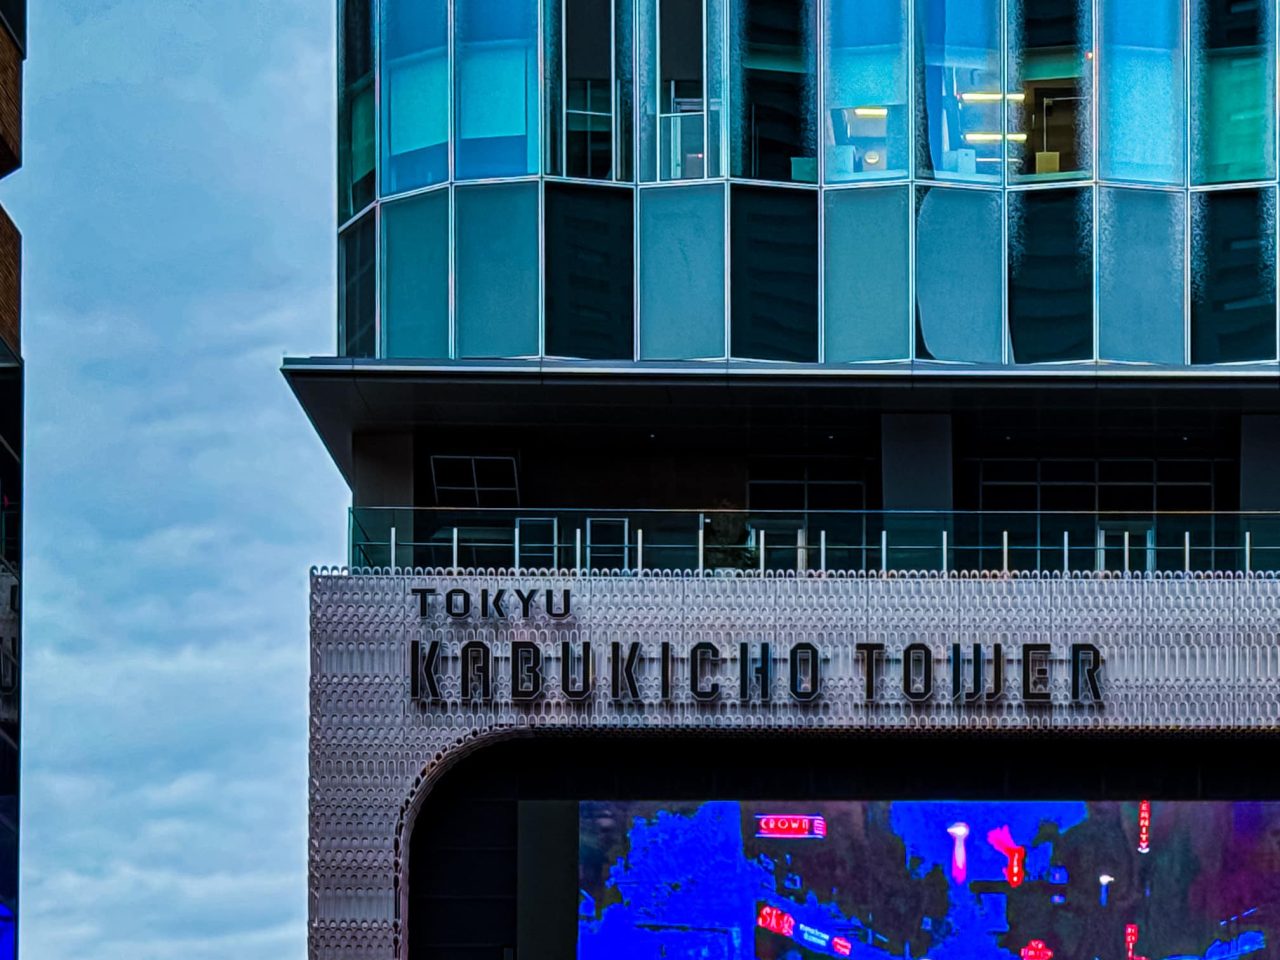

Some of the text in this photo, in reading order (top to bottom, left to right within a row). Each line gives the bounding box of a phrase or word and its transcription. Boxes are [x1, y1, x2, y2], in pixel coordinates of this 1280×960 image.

[412, 588, 572, 619] TOKYU
[410, 640, 1105, 704] KABUKICHO TOWER
